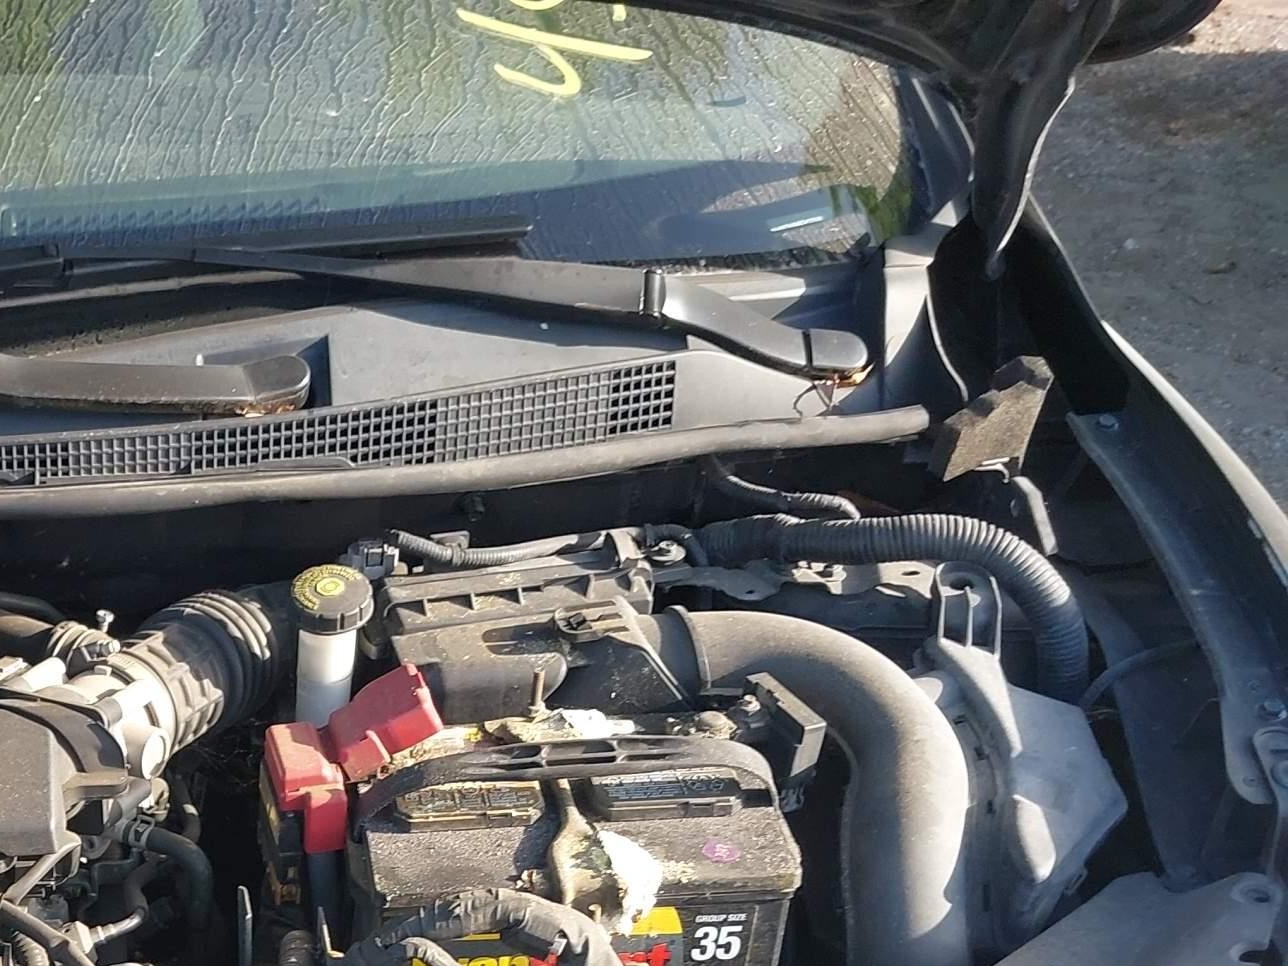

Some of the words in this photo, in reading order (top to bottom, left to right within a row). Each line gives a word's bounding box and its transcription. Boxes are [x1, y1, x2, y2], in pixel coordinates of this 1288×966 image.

[695, 914, 728, 923] GROUP
[728, 912, 748, 922] SIZE
[690, 925, 743, 961] 35
